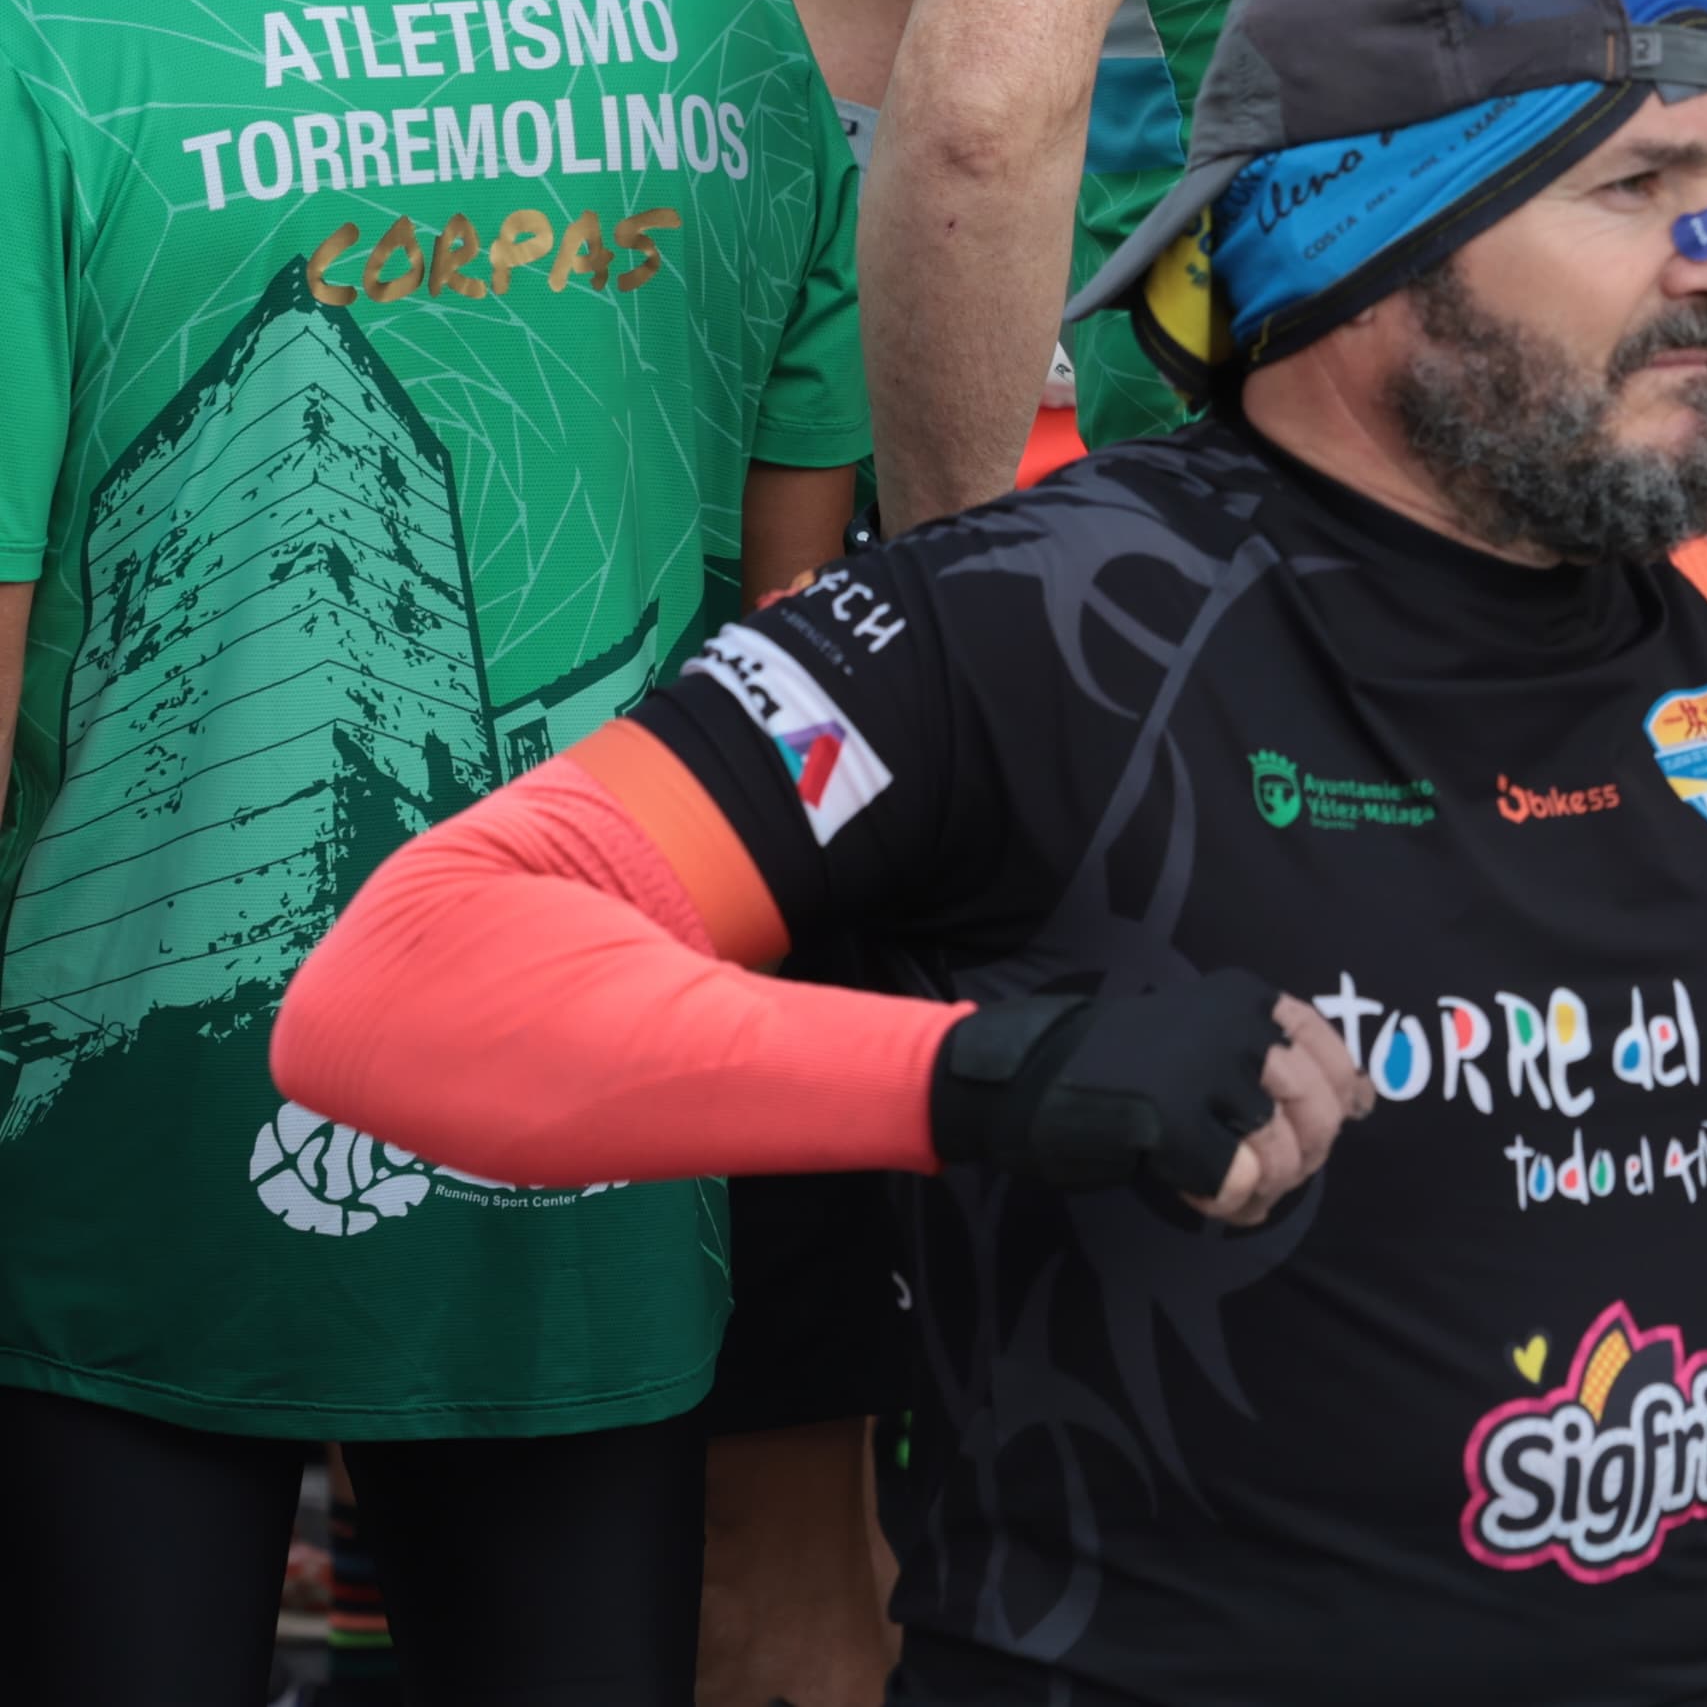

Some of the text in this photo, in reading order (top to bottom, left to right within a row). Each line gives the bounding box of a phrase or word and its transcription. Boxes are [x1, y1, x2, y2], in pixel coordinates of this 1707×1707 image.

[182, 93, 751, 212] TORREMOLINOS
[306, 208, 684, 307] CORPAS
[1612, 978, 1700, 1092] del
[434, 1183, 578, 1210] Running Sport Center
[1624, 1135, 1654, 1195] el
